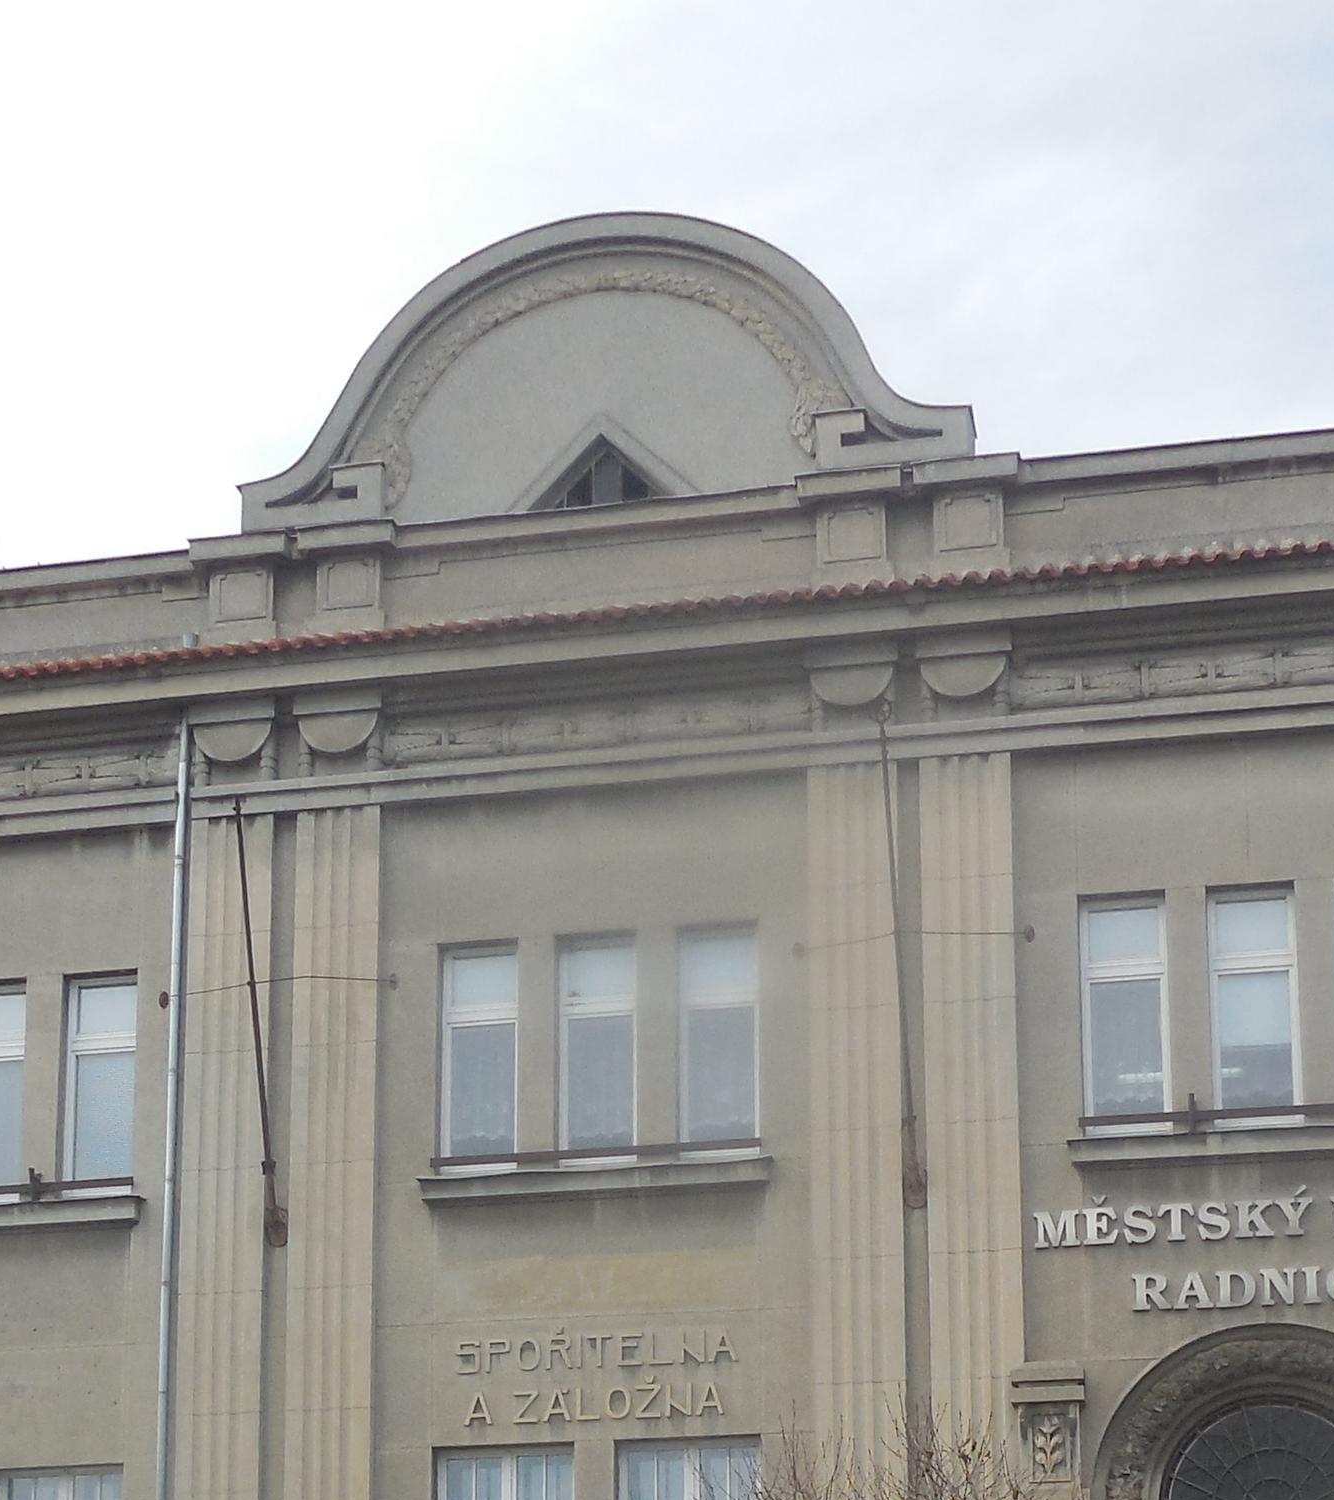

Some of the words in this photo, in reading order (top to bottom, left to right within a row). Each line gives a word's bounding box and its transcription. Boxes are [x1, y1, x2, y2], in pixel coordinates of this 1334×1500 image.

[1033, 1185, 1314, 1249] MĚSTSKÝ
[455, 1327, 739, 1375] SPOŘITELNA
[464, 1392, 493, 1427] A
